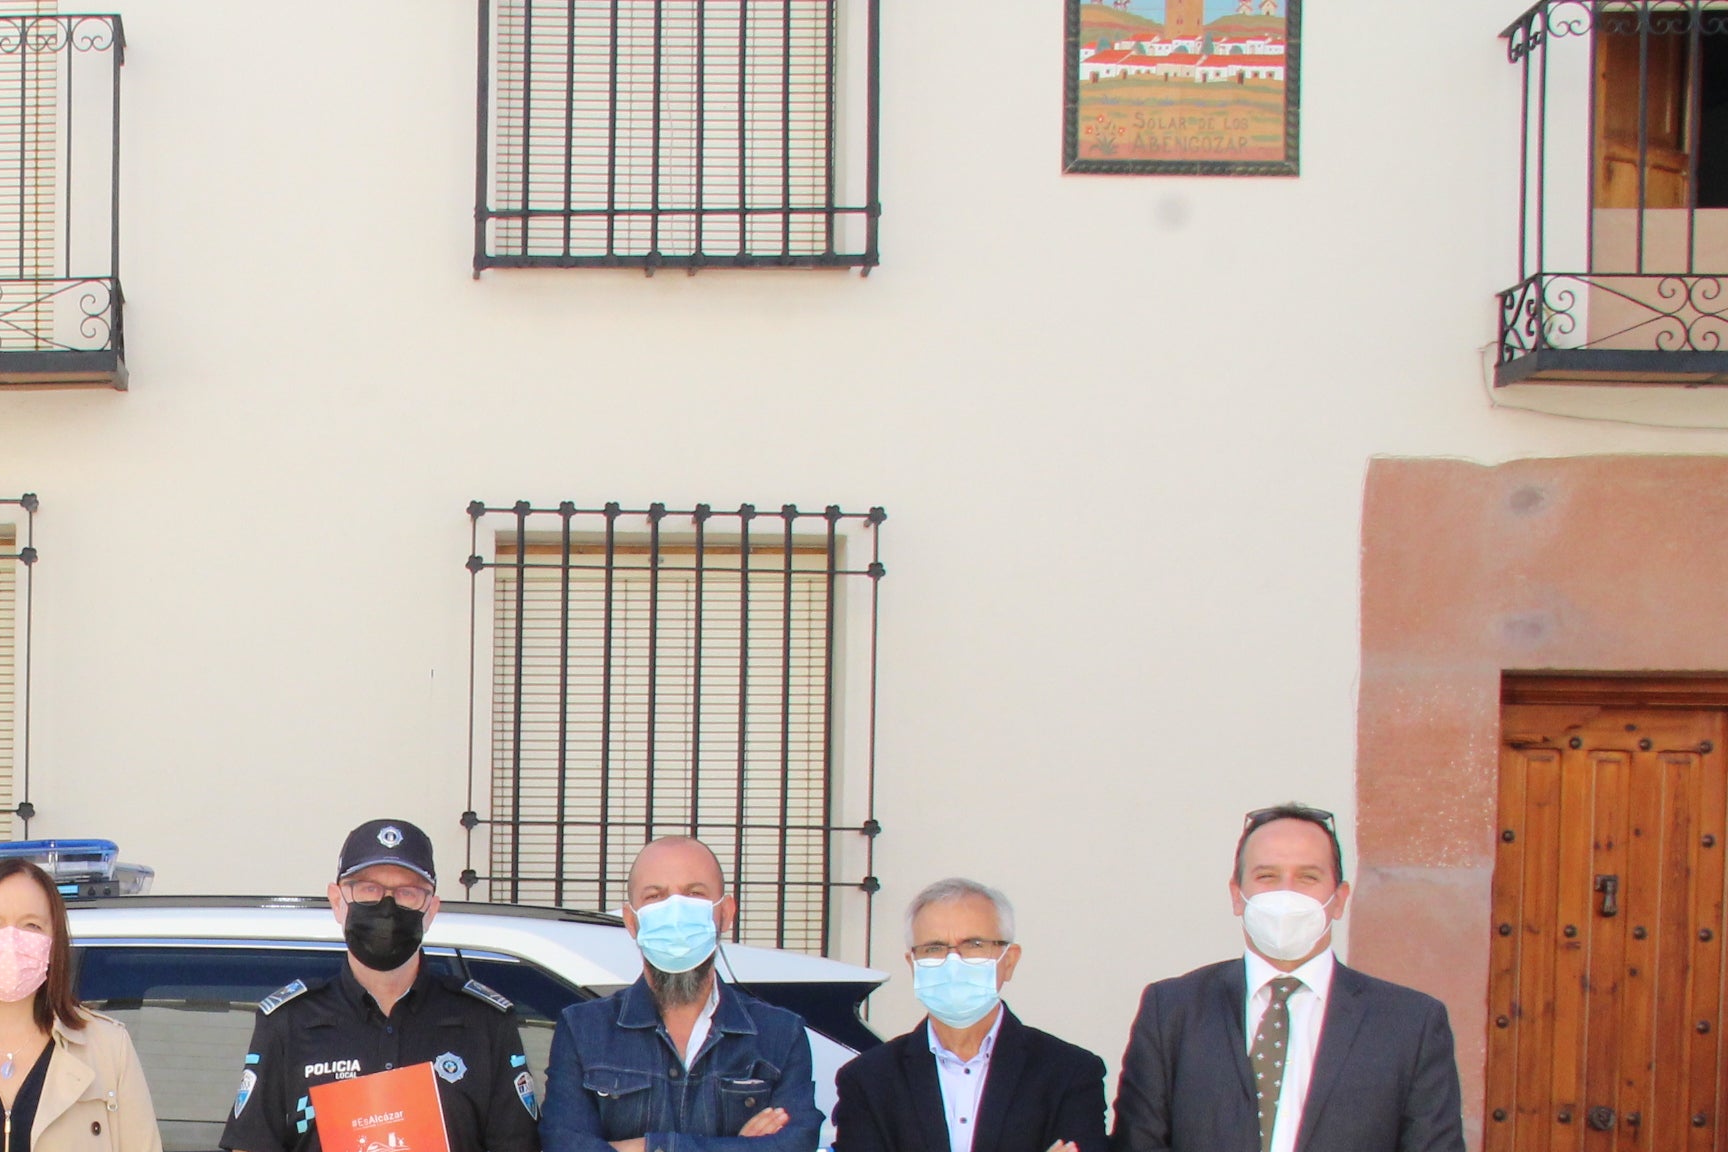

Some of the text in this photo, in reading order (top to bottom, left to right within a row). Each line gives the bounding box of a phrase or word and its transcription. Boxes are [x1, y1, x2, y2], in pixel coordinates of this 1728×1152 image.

[1133, 111, 1249, 130] SOLAR DE LOS
[304, 1059, 361, 1078] POLICIA
[335, 1071, 357, 1080] LOCAL
